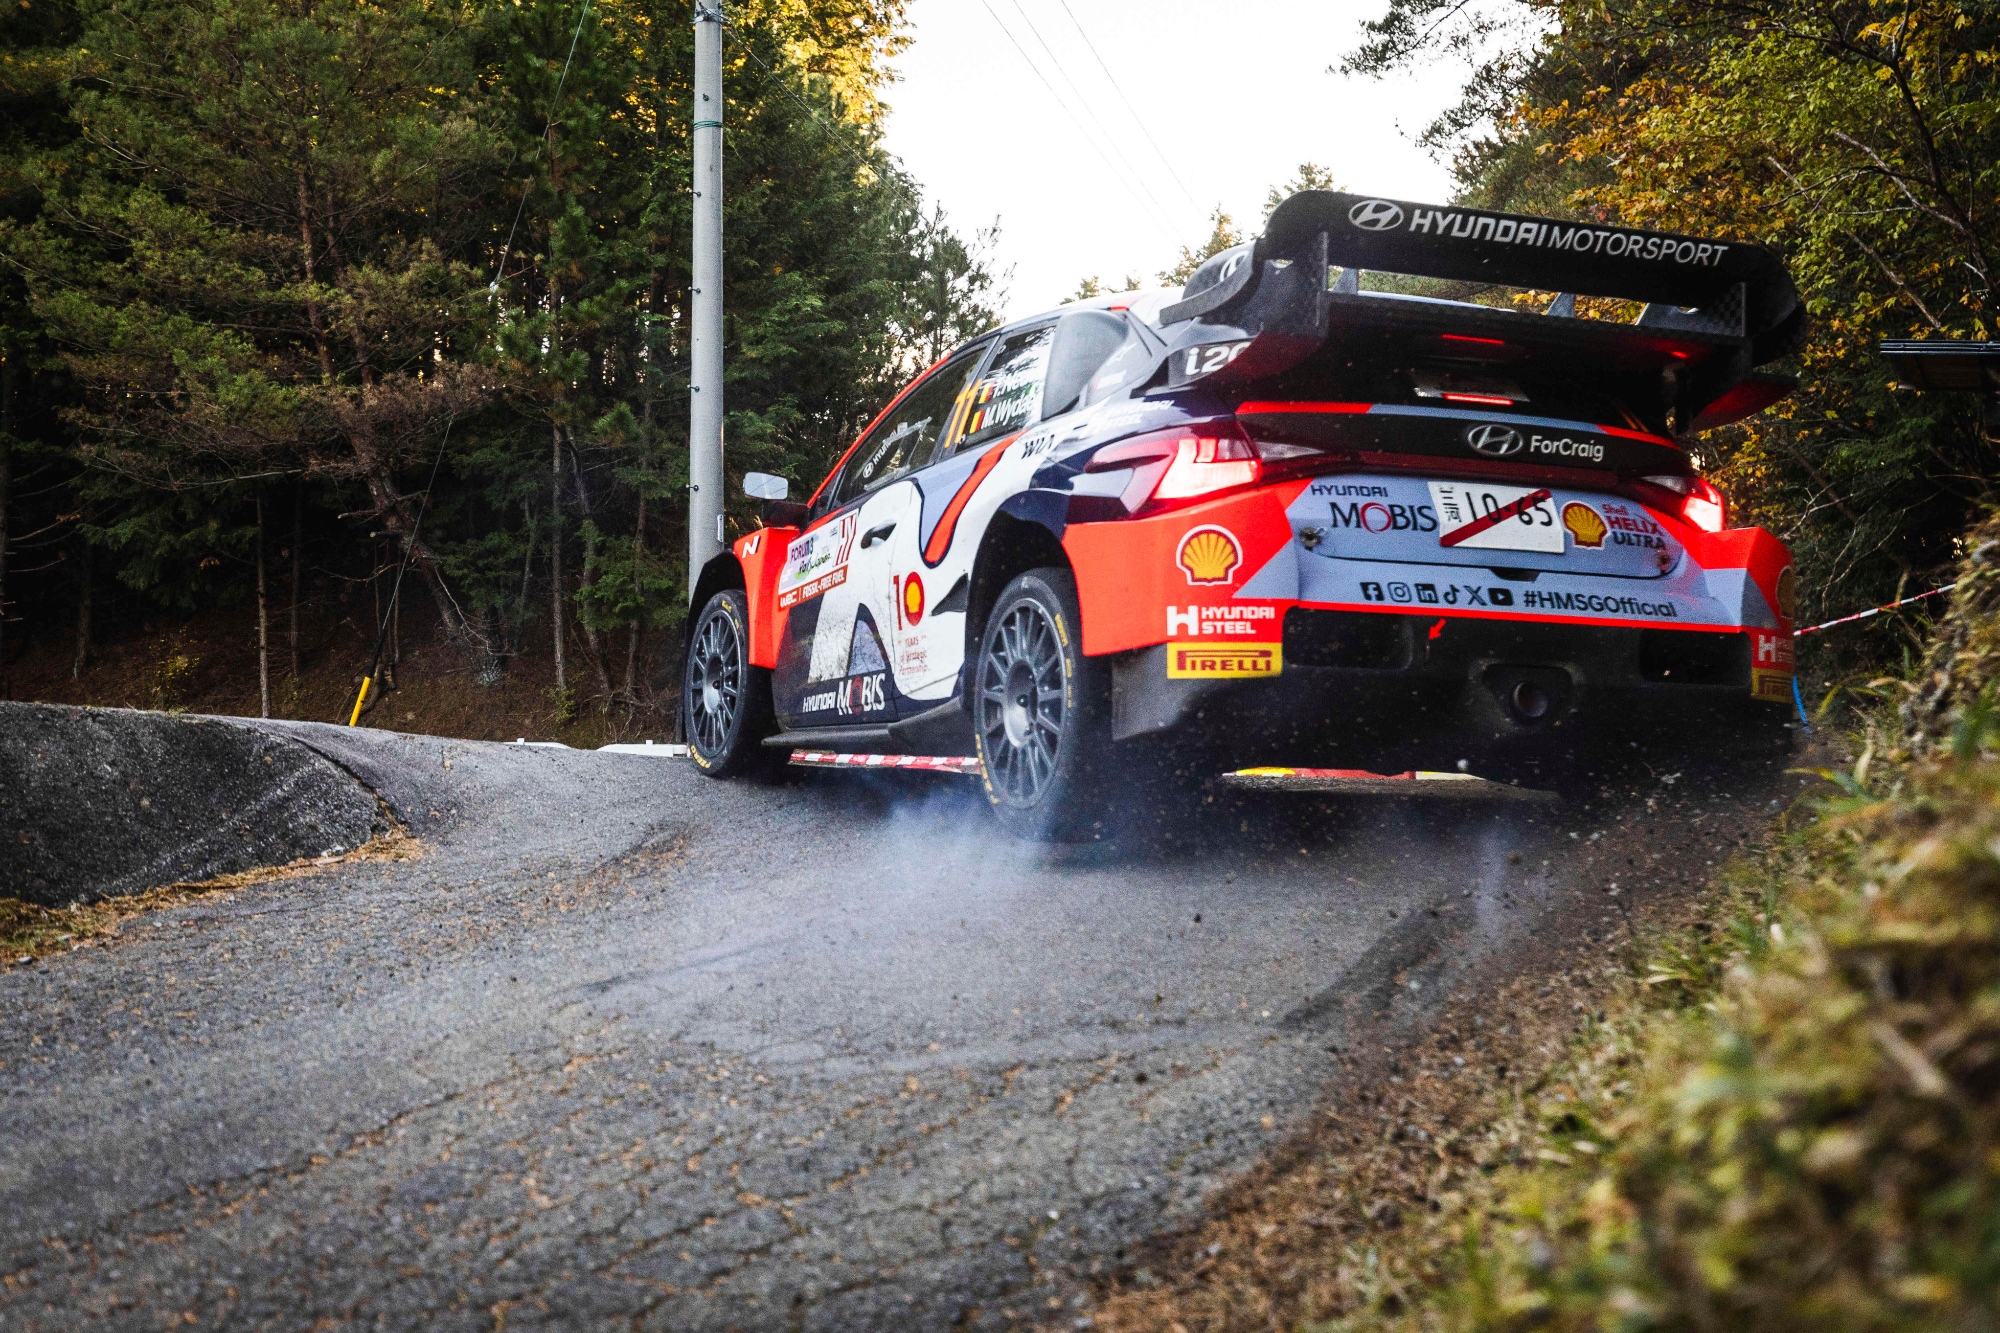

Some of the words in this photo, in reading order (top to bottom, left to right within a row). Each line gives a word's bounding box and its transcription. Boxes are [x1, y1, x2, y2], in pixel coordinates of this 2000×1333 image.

[1409, 209, 1547, 247] HYUNDAI
[1547, 226, 1729, 267] MOTORSPORT
[1529, 435, 1605, 462] ForCraig
[1310, 484, 1389, 498] HYUNDAI
[1328, 502, 1438, 534] MOBIS
[1601, 503, 1630, 516] Shell
[1605, 514, 1665, 537] HELIX
[1612, 531, 1667, 551] ULTRA
[1201, 606, 1275, 619] HYUNDAI
[1523, 590, 1678, 618] #HMSGOfficial
[1201, 621, 1257, 634] STEEL
[1176, 649, 1273, 671] PIRELLI
[803, 691, 836, 713] HYUNDAI
[837, 673, 886, 715] MOBIS
